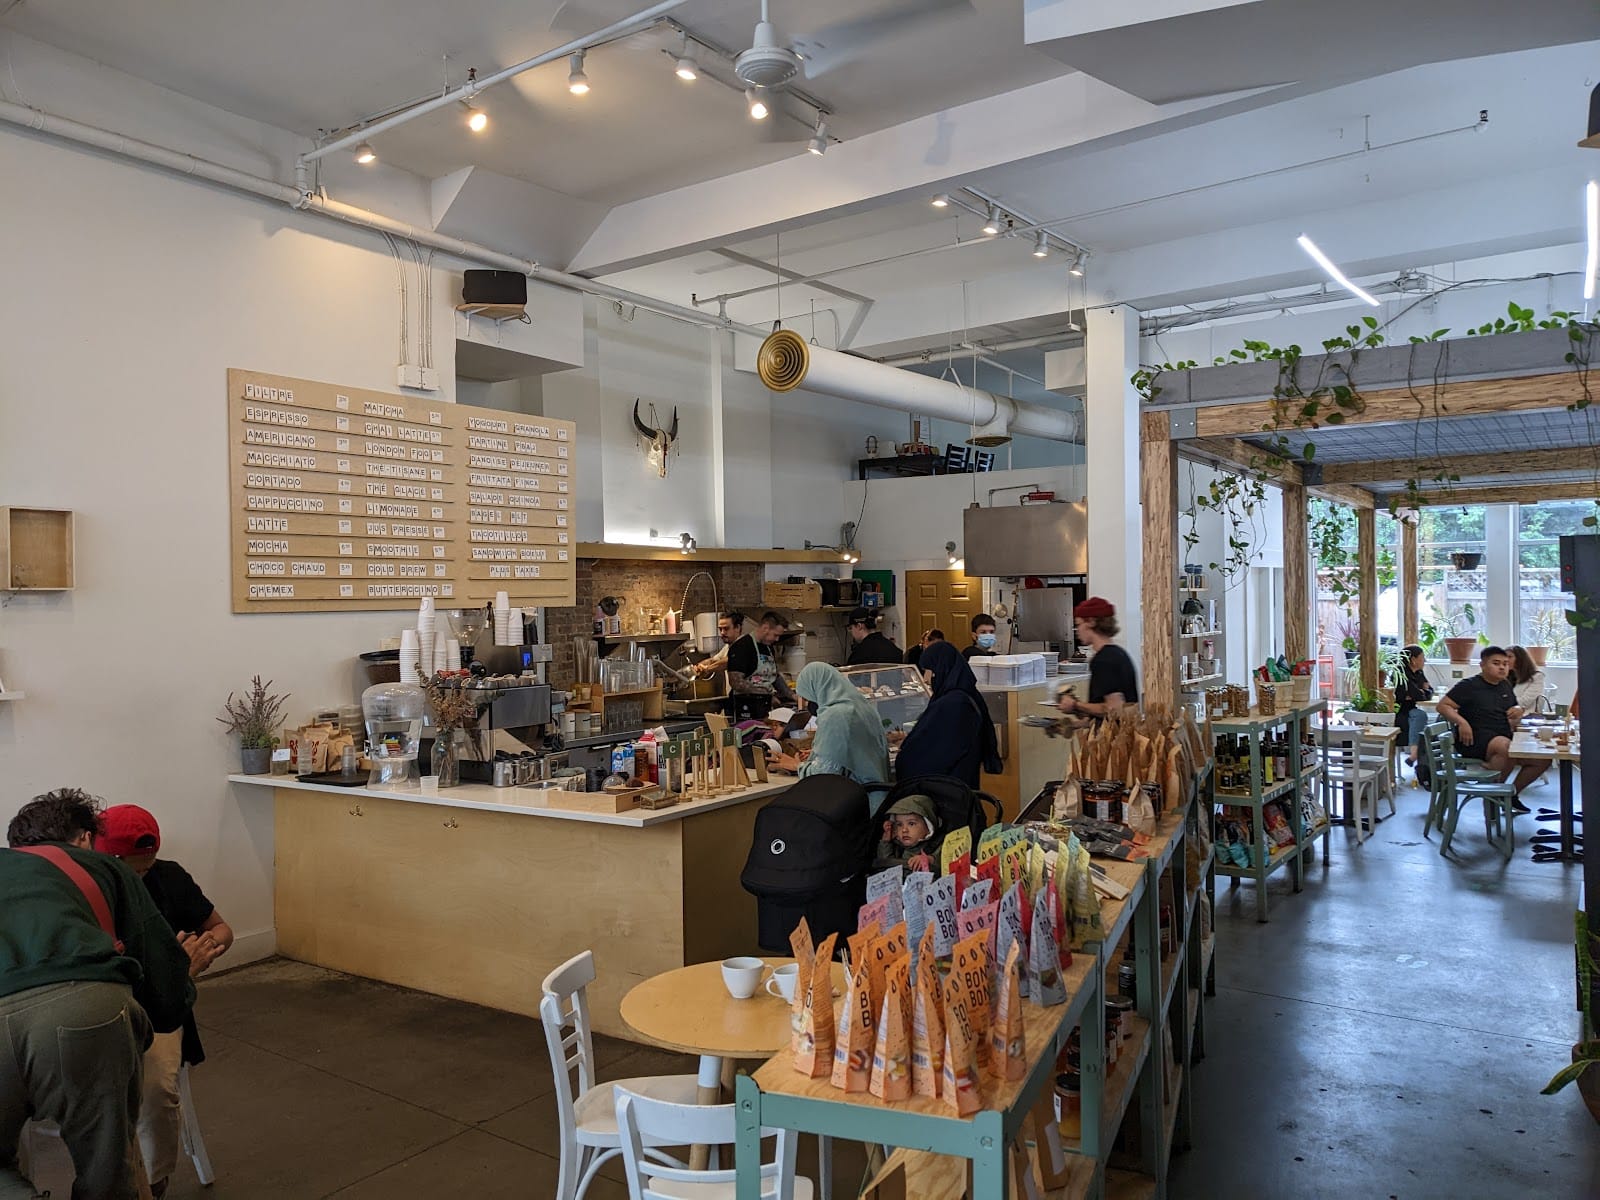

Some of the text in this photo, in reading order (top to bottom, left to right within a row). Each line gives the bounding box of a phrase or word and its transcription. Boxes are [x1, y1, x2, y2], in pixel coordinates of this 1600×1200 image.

[247, 385, 293, 399] FILTRE
[364, 403, 404, 416] MATCHA
[247, 408, 308, 423] ESPRESSO
[366, 423, 392, 435] CHAI
[398, 429, 430, 439] LATTE
[469, 418, 507, 430] YOGOURT
[515, 424, 549, 434] GRANOLA
[248, 430, 315, 445] AMERICANO
[470, 436, 508, 448] TARTINE
[367, 443, 406, 456] LONDON
[248, 453, 316, 466] MACCHIATO
[470, 455, 507, 466] DANOISE
[248, 474, 301, 486] CORTADO
[249, 497, 323, 508] CAPPUCCINO
[368, 505, 419, 515] LIMONADE
[249, 519, 288, 528] LATTE
[368, 524, 386, 533] JUS
[249, 541, 288, 550] MOCHA
[368, 545, 419, 555] SMOOTHIE
[472, 548, 517, 557] SANDWICH
[249, 563, 284, 571] CHOCO
[292, 563, 325, 572] CHAUD
[368, 565, 394, 573] COLD
[400, 566, 427, 574] BREW
[490, 566, 539, 574] PLUS TAXES
[250, 586, 293, 594] CHEMEX
[369, 586, 438, 594] BUTTERCCINO
[669, 745, 677, 754] C
[694, 742, 701, 751] R
[941, 924, 956, 939] BO
[965, 963, 989, 989] BON
